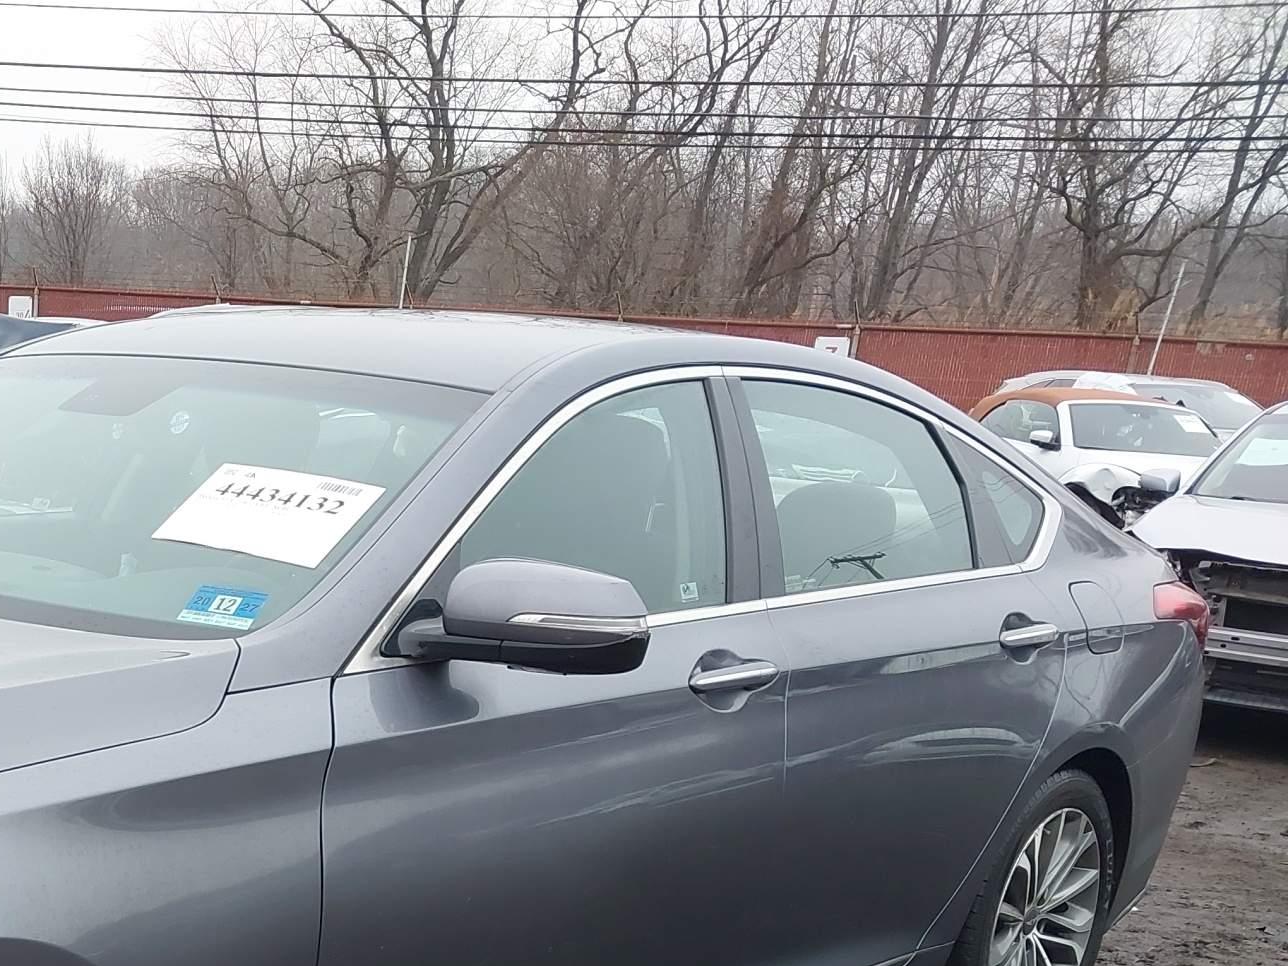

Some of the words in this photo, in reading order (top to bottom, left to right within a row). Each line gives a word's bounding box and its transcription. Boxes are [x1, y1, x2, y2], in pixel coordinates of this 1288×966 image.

[215, 482, 346, 515] 44434132
[192, 595, 212, 606] 20
[213, 597, 238, 612] 12
